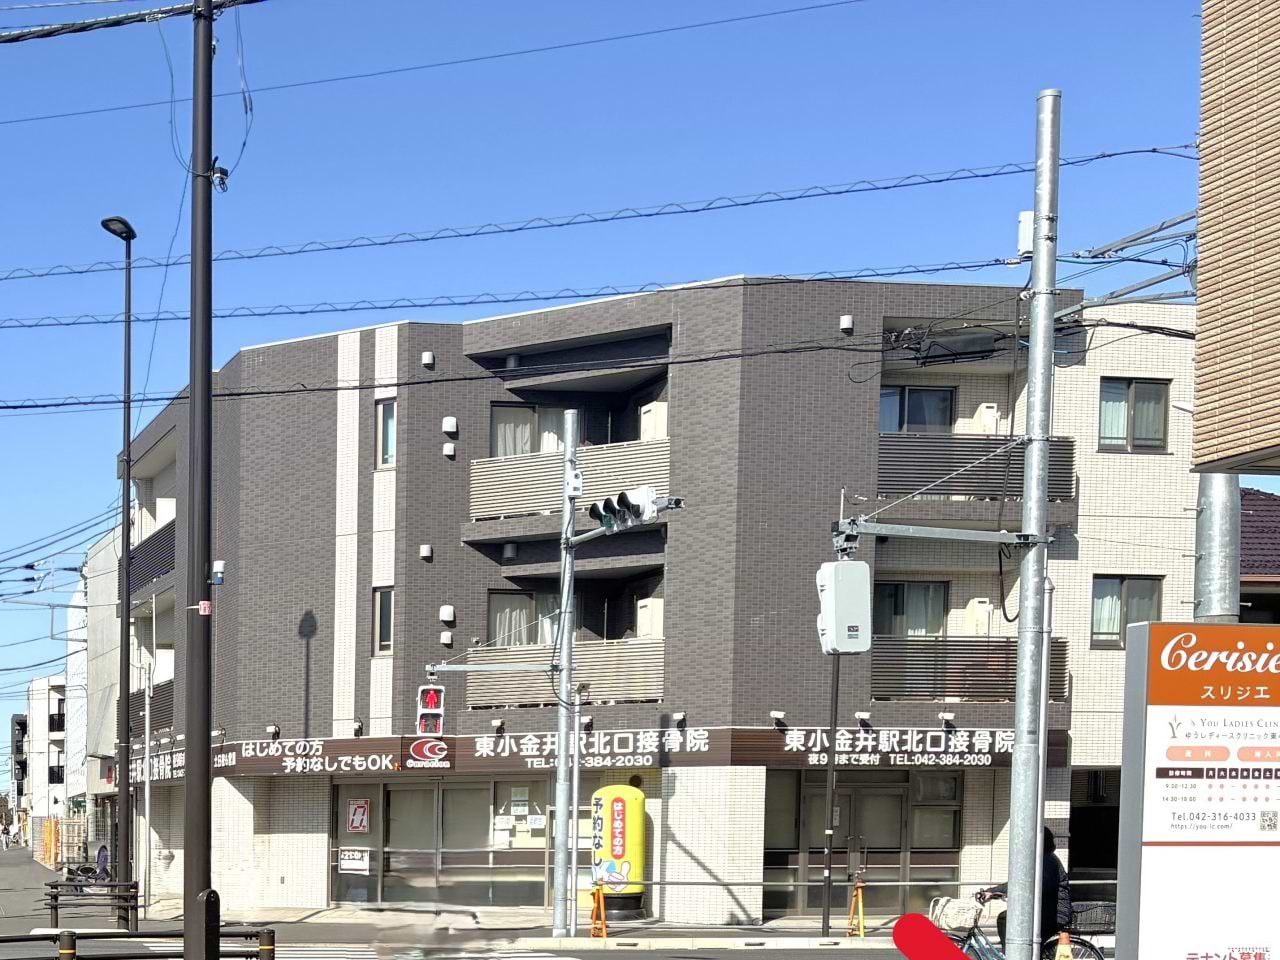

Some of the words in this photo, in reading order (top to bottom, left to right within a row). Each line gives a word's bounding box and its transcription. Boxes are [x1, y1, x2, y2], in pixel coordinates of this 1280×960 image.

[1200, 685, 1271, 701] スリジエ
[241, 740, 324, 757] はじめての方
[474, 730, 710, 758] 東小金井駅北口接骨院
[784, 729, 1016, 753] 東小金井駅北口接骨院
[281, 754, 394, 774] 予約なしでもOK
[807, 752, 881, 766] 夜9まで受付
[888, 752, 992, 767] TEL:042-384-2030
[1172, 811, 1257, 821] Tel.042-316-4033
[612, 801, 624, 856] はじめての方
